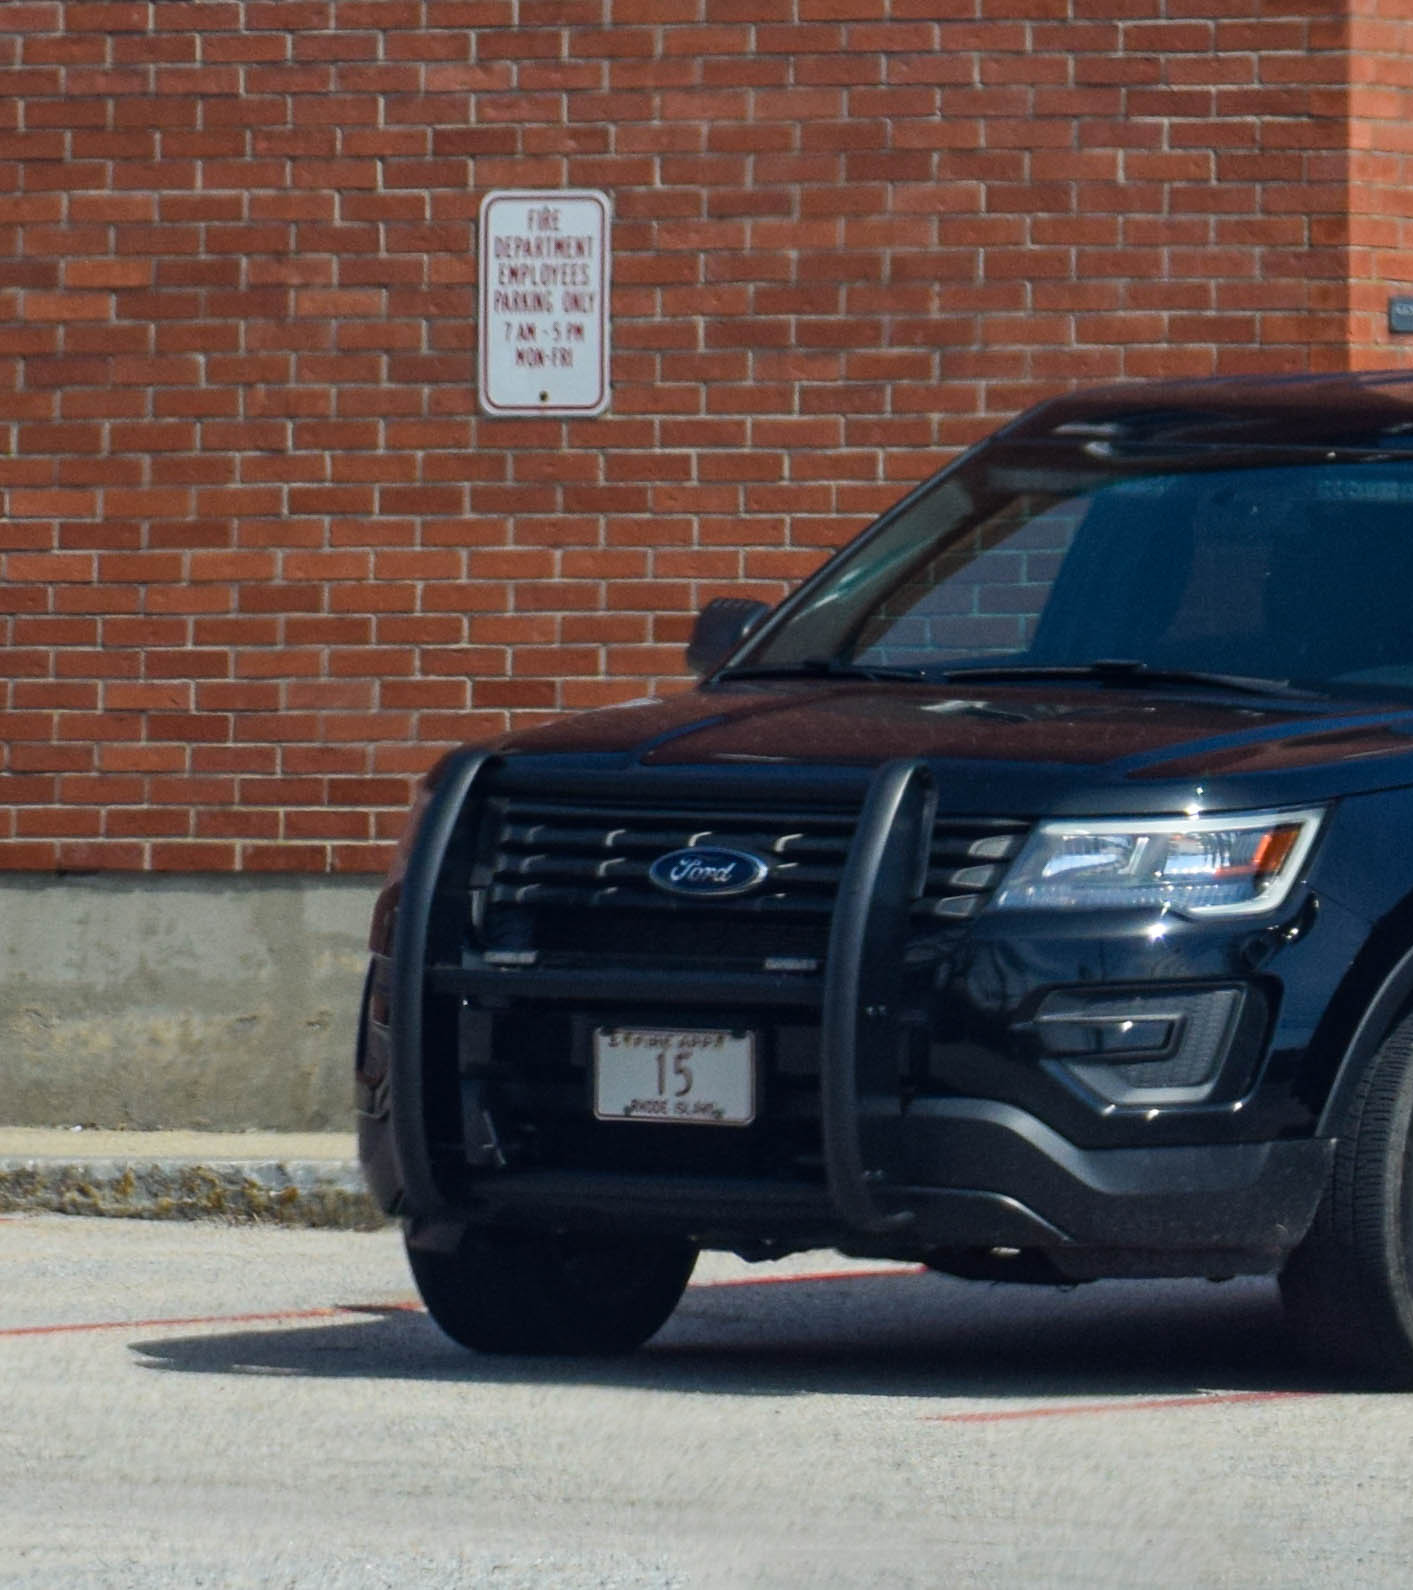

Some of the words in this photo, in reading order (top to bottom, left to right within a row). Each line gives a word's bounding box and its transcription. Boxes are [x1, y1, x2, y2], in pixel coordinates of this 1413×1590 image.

[528, 208, 560, 231] FIRE
[494, 236, 592, 258] DEPARTMENT
[499, 263, 590, 285] EMPLOYEES
[494, 290, 553, 313] PARKING
[562, 291, 595, 313] ONLY
[504, 321, 513, 342] 7
[518, 322, 536, 342] AM
[552, 322, 561, 342] 5
[567, 322, 585, 342] PM
[515, 347, 574, 368] MON-FRI
[670, 858, 737, 882] Ford
[656, 1050, 694, 1097] 15
[631, 1099, 667, 1114] RHODE
